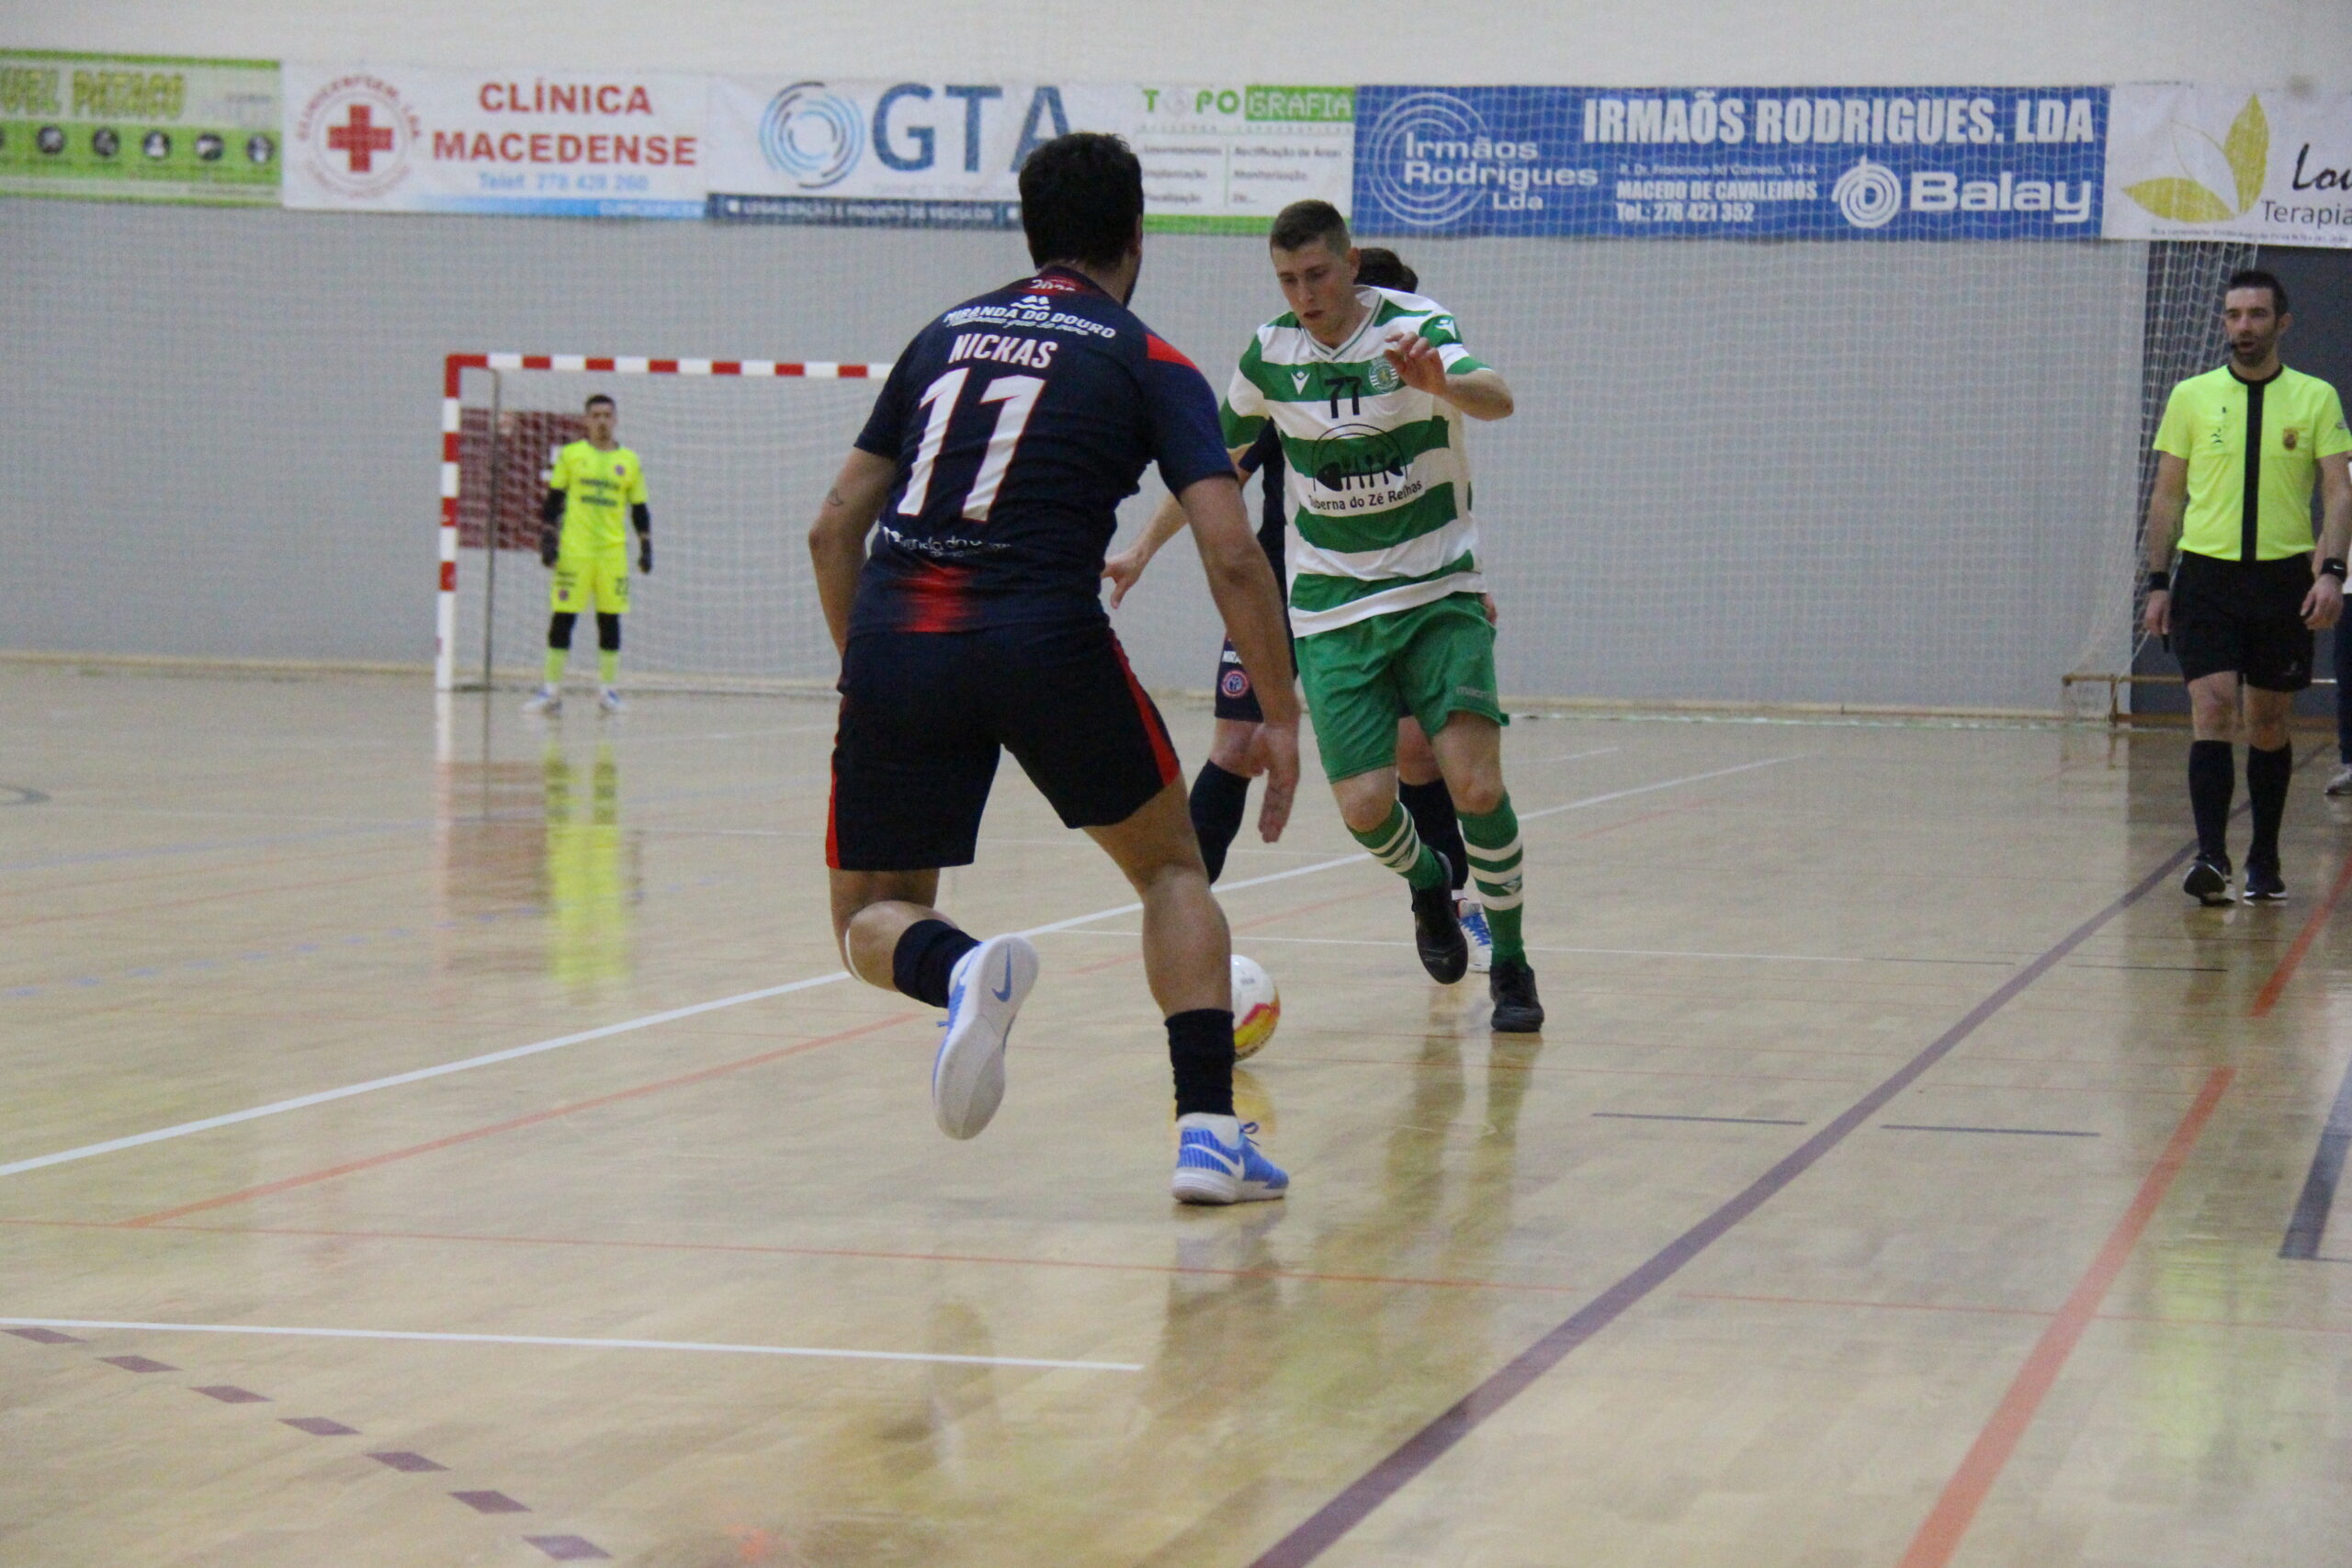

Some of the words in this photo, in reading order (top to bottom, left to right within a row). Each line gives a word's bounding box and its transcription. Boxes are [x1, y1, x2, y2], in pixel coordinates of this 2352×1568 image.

[480, 78, 653, 115] CLÍNICA
[872, 83, 1071, 173] GTA
[1584, 90, 1746, 144] IRMAÕS
[2015, 98, 2095, 143] LDA
[433, 131, 698, 166] MACEDENSE
[1406, 131, 1538, 159] Irmãos
[1404, 160, 1599, 191] Rodrigues
[1616, 180, 1688, 199] MACEDO
[1690, 181, 1713, 199] DE
[1715, 180, 1818, 200] CAVALEIROS
[1493, 191, 1544, 210] Lda
[1654, 202, 1684, 221] 278
[1687, 202, 1718, 221] 421
[1721, 202, 1755, 221] 352
[1910, 171, 2091, 223] Balay
[2261, 199, 2352, 230] Terapia
[943, 306, 1019, 323] MIRANDA
[1022, 310, 1050, 321] DO
[1050, 312, 1116, 339] DOURO
[947, 333, 1059, 368] NICKAS
[1325, 376, 1363, 419] 77
[897, 367, 1047, 523] 11
[1350, 496, 1365, 508] do
[1368, 492, 1385, 507] Zé
